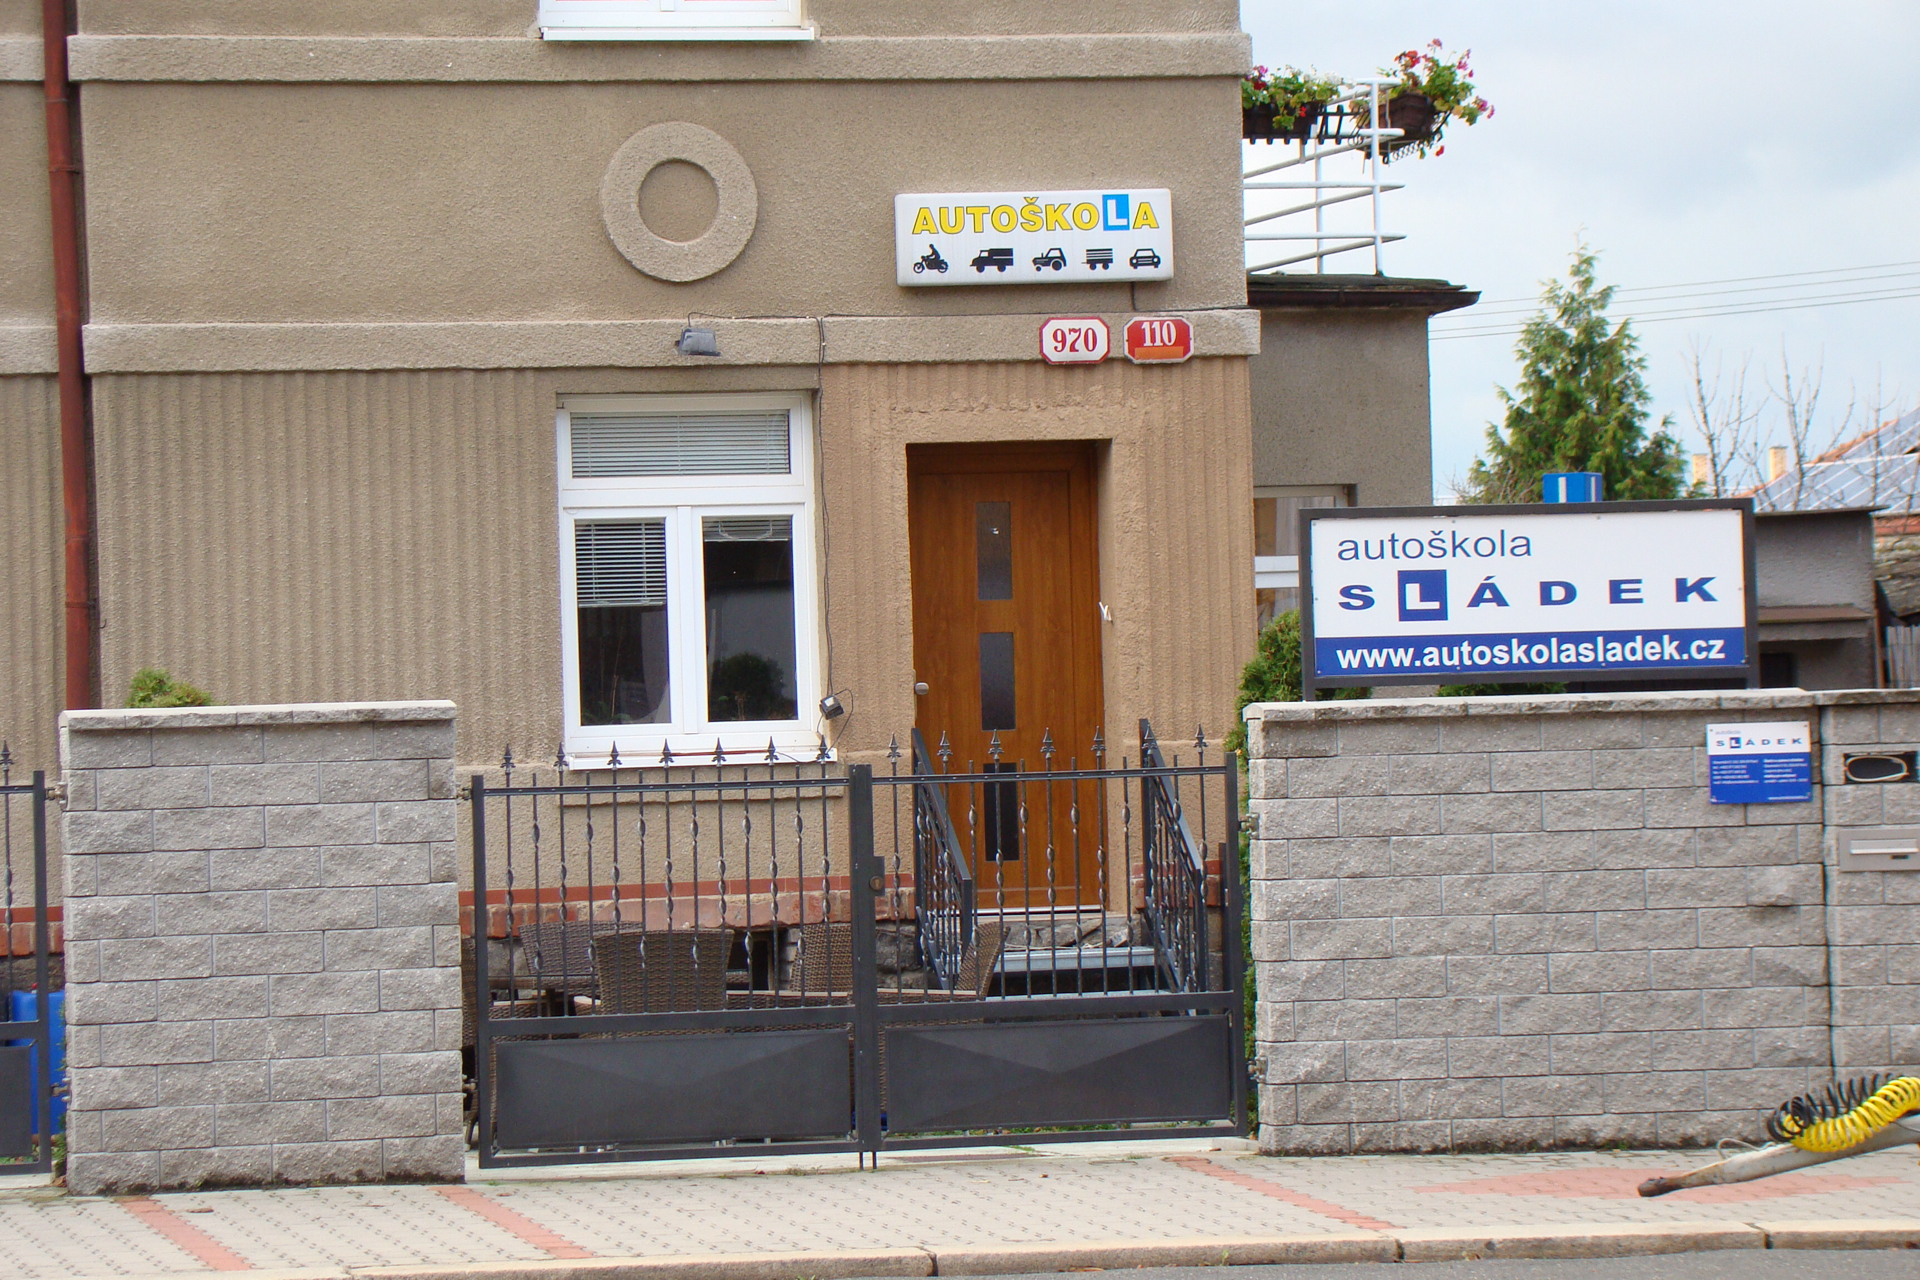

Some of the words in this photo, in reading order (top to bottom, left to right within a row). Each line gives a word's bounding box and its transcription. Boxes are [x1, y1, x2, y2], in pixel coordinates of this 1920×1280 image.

[912, 196, 1159, 234] AUTOŠKOLA
[1053, 328, 1098, 352] 970
[1141, 321, 1177, 347] 110
[1337, 529, 1532, 561] autoškola
[1338, 573, 1718, 614] SLÁDEK
[1336, 634, 1726, 669] www.autoskolasladek.cz
